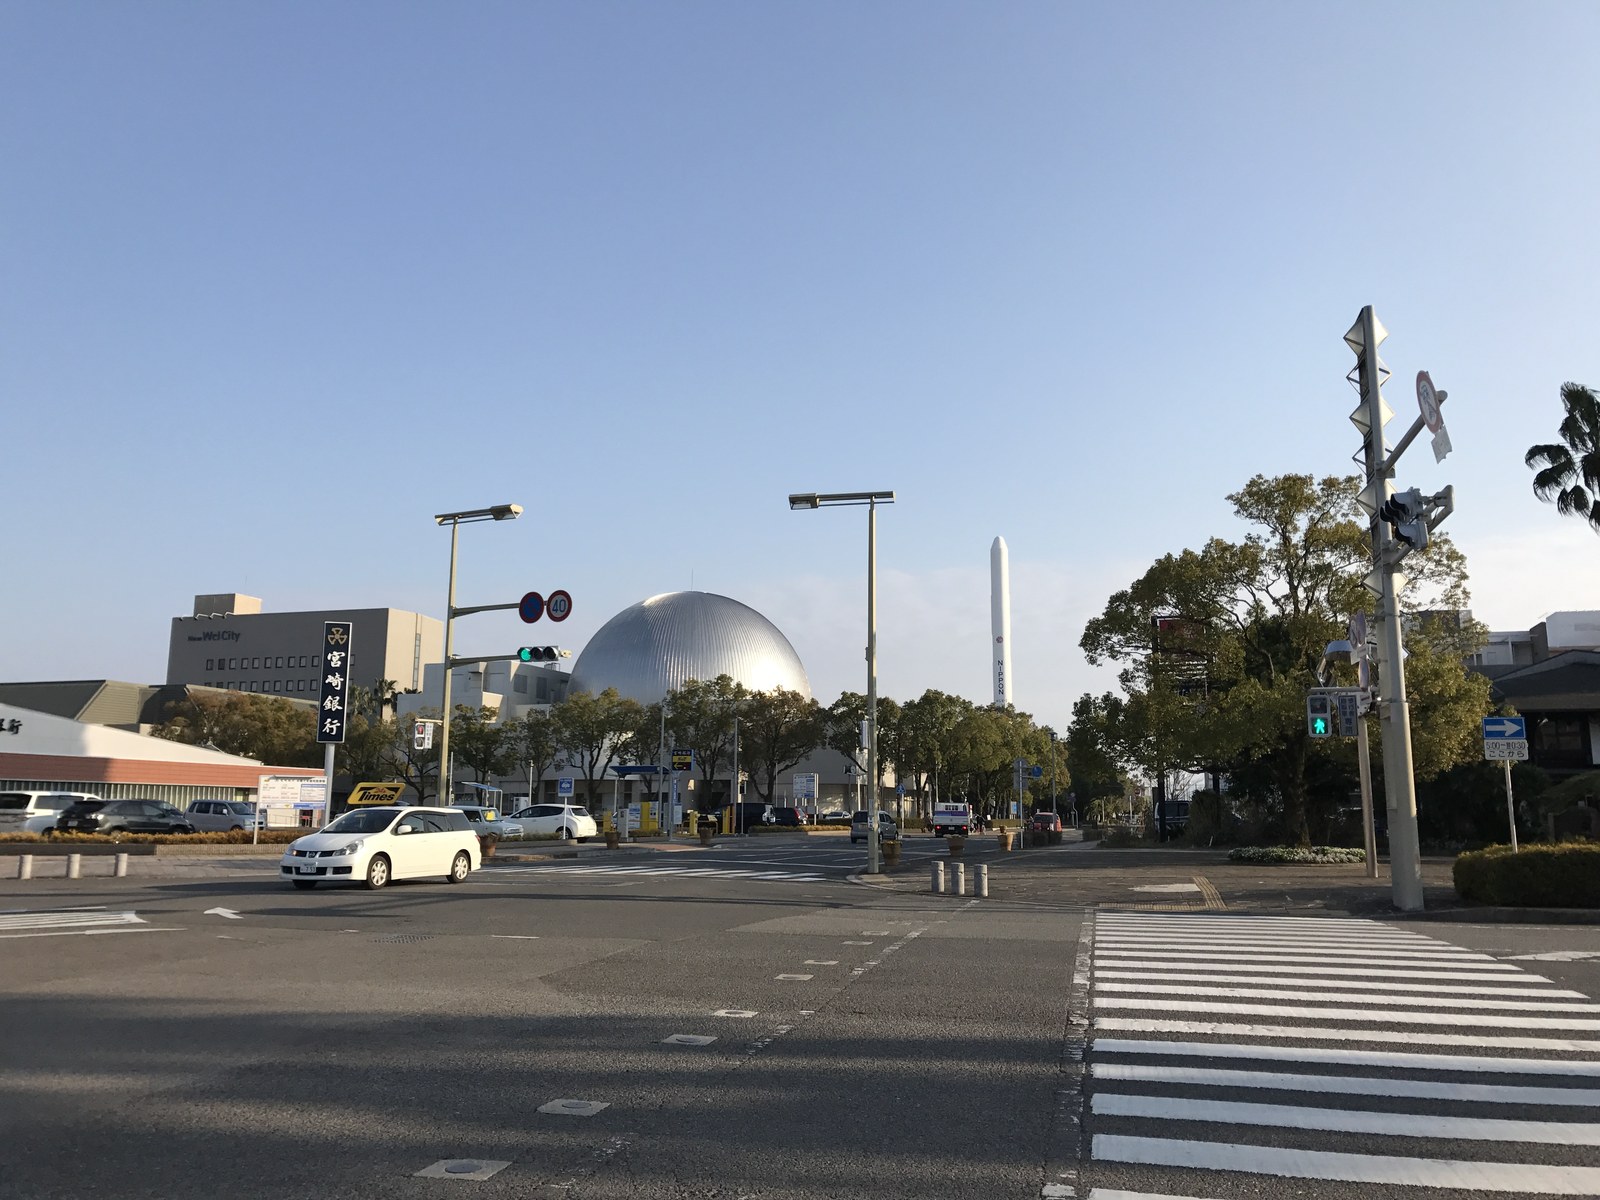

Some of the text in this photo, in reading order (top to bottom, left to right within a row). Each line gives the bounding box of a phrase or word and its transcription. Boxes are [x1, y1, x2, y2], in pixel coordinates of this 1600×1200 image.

[552, 599, 567, 613] 40
[322, 651, 346, 735] 宮崎銀行
[1489, 750, 1525, 758] ここから
[356, 786, 401, 802] Times
